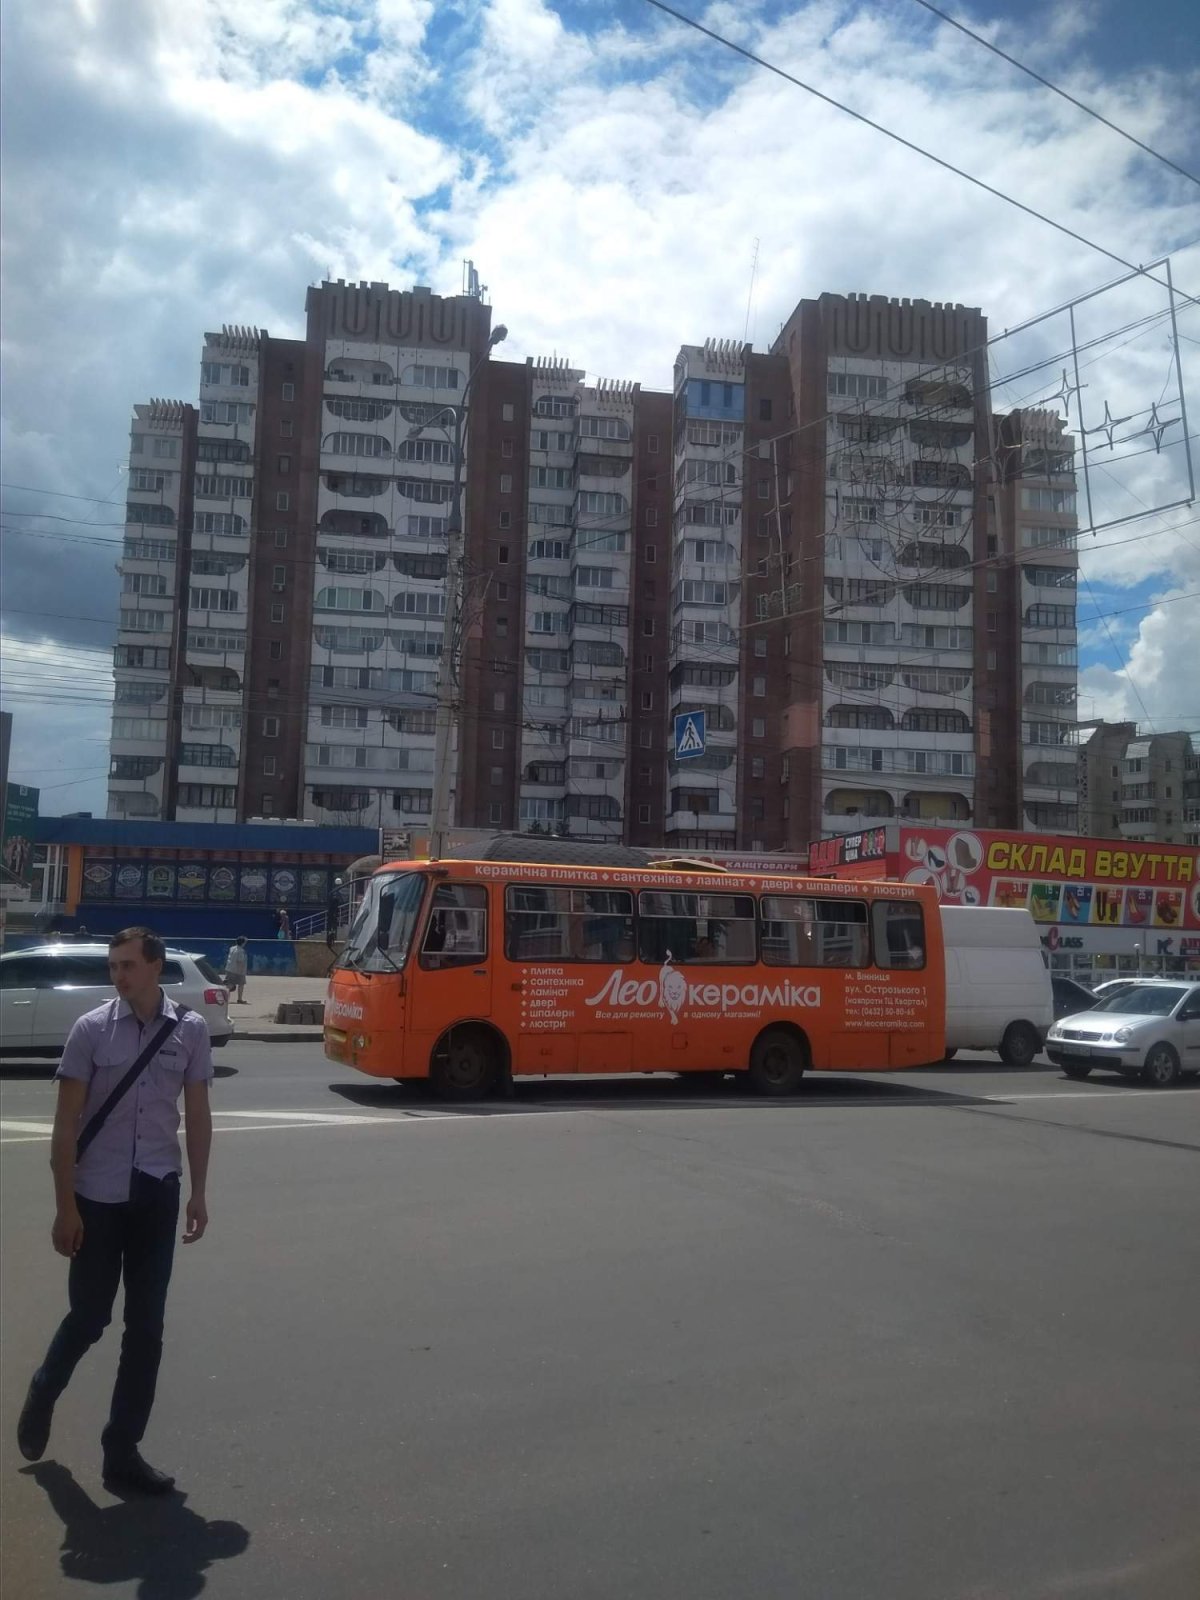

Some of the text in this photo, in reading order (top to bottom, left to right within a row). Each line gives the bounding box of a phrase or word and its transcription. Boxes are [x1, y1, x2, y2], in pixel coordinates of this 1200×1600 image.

[725, 861, 798, 871] КАНЦТОВАРИ
[987, 842, 1193, 882] СКЛАД ВЗУТТЯ
[474, 865, 915, 897] керамічна плитка сантехніка ламінат двері шпалери люстри
[530, 968, 564, 976] плитка
[856, 972, 890, 981] Вінниця
[530, 978, 584, 986] сантехніка
[530, 988, 568, 997] ламінат
[584, 969, 821, 1011] Лео кераміка
[845, 986, 862, 995] вул.
[864, 985, 920, 996] Острозького
[530, 999, 557, 1009] двері
[529, 1011, 575, 1019] шпалери
[595, 1011, 612, 1019] Все
[613, 1012, 629, 1020] для
[629, 1012, 665, 1020] ремонту
[691, 1012, 721, 1020] одному
[529, 1020, 566, 1030] люстри
[845, 1019, 925, 1029] www.leoceramika.com
